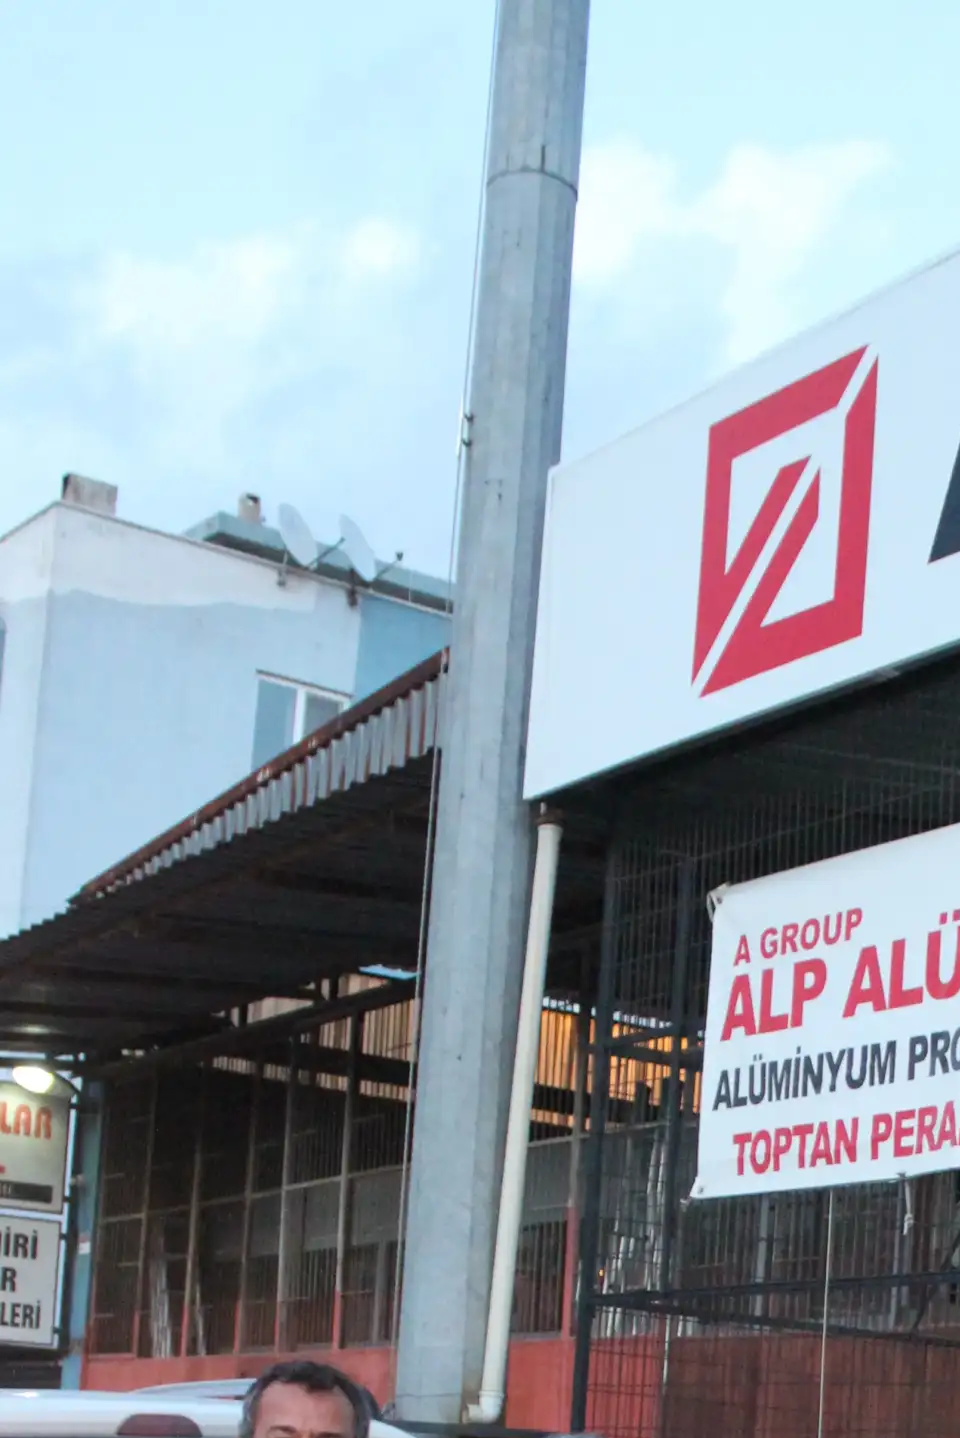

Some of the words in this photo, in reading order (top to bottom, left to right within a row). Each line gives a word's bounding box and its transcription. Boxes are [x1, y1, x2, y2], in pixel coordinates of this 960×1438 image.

[733, 934, 752, 967] A
[760, 907, 863, 960] GROUP
[720, 957, 828, 1041] ALP
[712, 1039, 898, 1112] ALÜMİNYUM
[732, 1116, 859, 1176] TOPTAN
